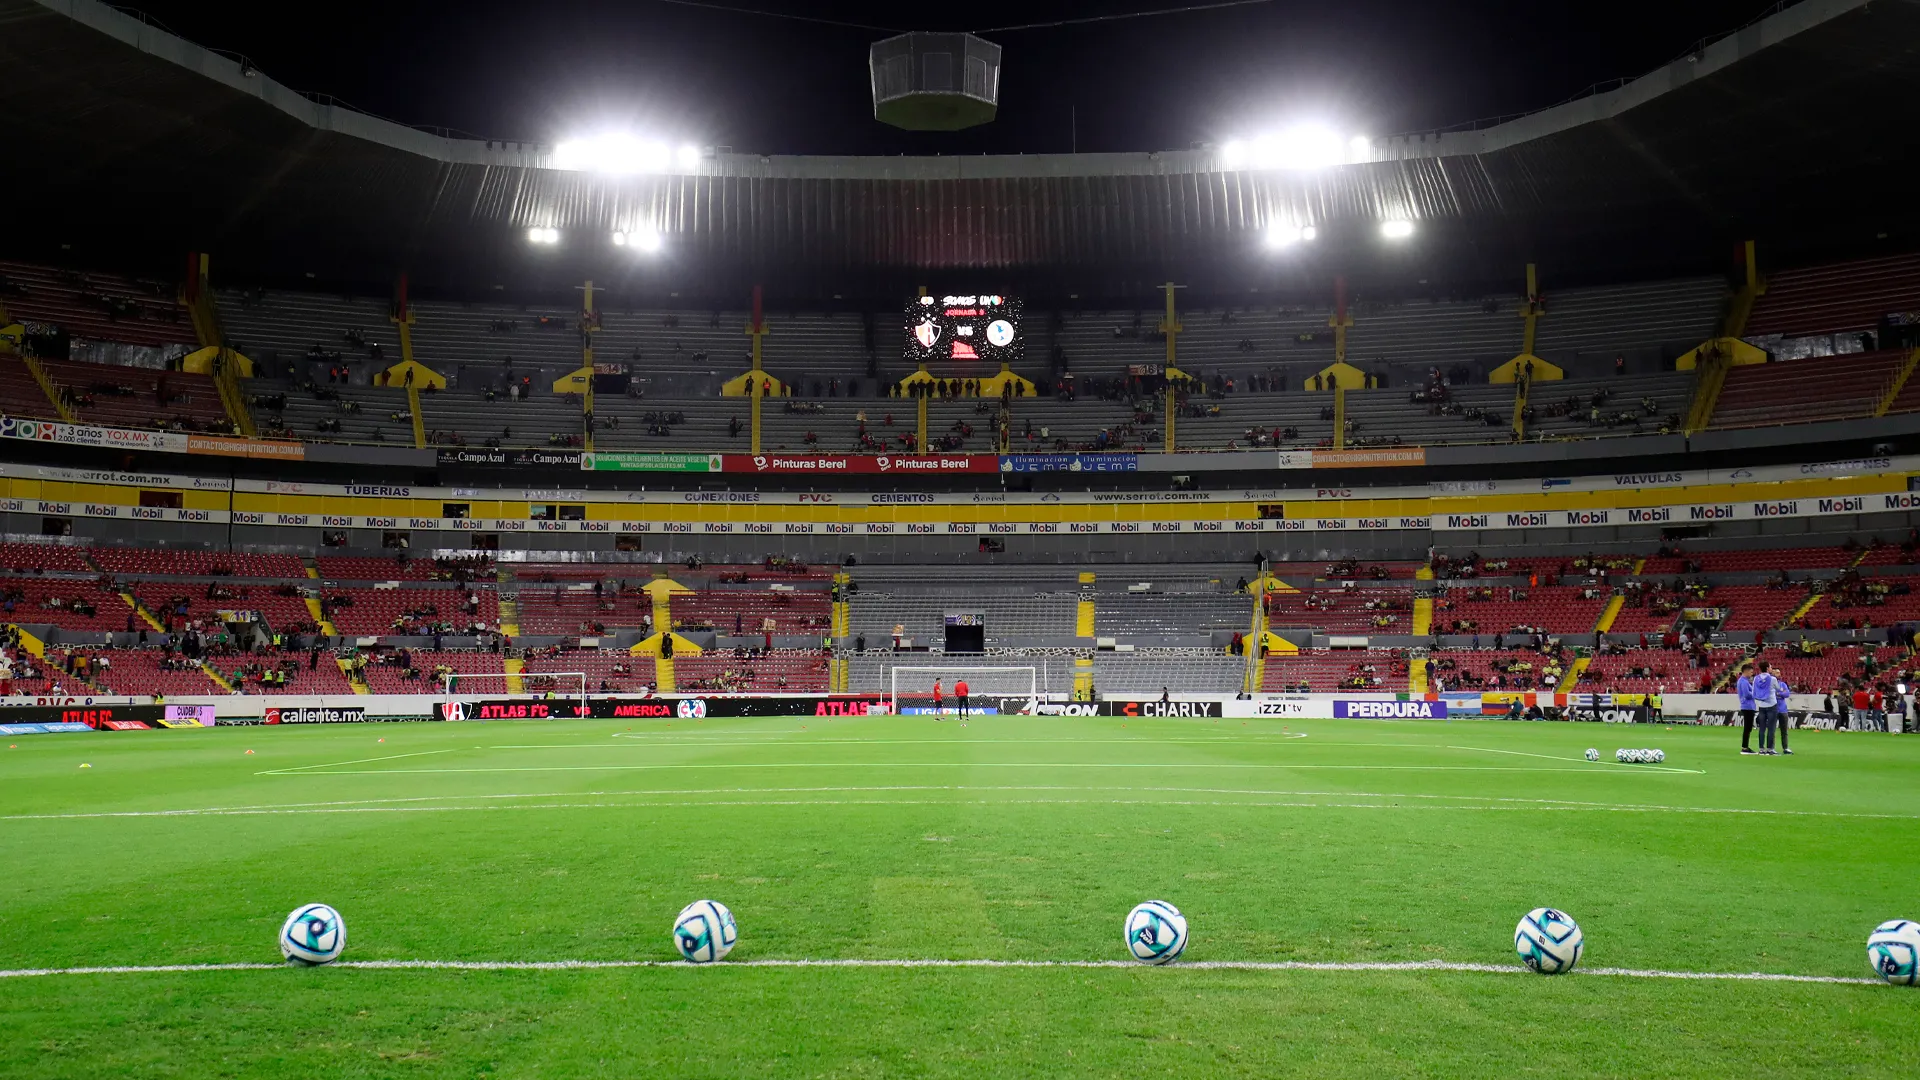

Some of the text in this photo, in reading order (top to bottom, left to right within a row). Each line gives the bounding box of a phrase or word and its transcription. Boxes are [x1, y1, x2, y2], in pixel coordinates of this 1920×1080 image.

[957, 326, 973, 335] VS
[68, 426, 75, 435] 3
[77, 428, 102, 438] años
[107, 431, 150, 441] YOX.MX
[458, 452, 505, 463] Campo Azul
[533, 454, 580, 465] Campo Azul
[773, 459, 847, 469] Pinturas Berel
[896, 459, 969, 469] Pinturas Berel
[1615, 473, 1682, 485] VALVULAS
[344, 486, 410, 496] TUBERIAS
[1317, 489, 1351, 498] PVC
[799, 494, 832, 502] PVC
[871, 494, 934, 502] CEMENTOS
[1093, 493, 1210, 501] www.serrot.com.mx
[39, 502, 70, 514] Mobil
[85, 505, 116, 516] Mobil
[132, 507, 162, 519] Mobil
[178, 509, 208, 521] Mobil
[1449, 515, 1487, 528] Mobil
[1508, 513, 1546, 527] Mobil
[1568, 510, 1607, 524] Mobil
[1629, 508, 1669, 522] Mobil
[1691, 505, 1733, 520] Mobil
[1755, 501, 1797, 516] Mobil
[1819, 497, 1862, 513] Mobil
[232, 512, 1429, 533] Mobil Mobil Mobil Mobil Mobil Mobil Mobil Mobil Mobil Mobil Mobil Mobil Mobil Mobil Mobil Mobil Mobil Mobil Mobil Mobil Mobil Mobil Mobil Mobil Mobil Mobil Mobil Mobil Mobil
[1702, 609, 1714, 618] 13
[481, 706, 526, 717] ATLAS
[531, 705, 548, 716] FC
[614, 706, 671, 716] AMERICA
[815, 702, 868, 716] ATLAS
[1143, 703, 1210, 716] CHARLY
[1293, 704, 1302, 712] tv
[1347, 702, 1432, 717] PERDURA
[62, 711, 96, 728] ATLAS
[281, 710, 365, 722] caliente.mx
[1698, 711, 1726, 726] AKRON
